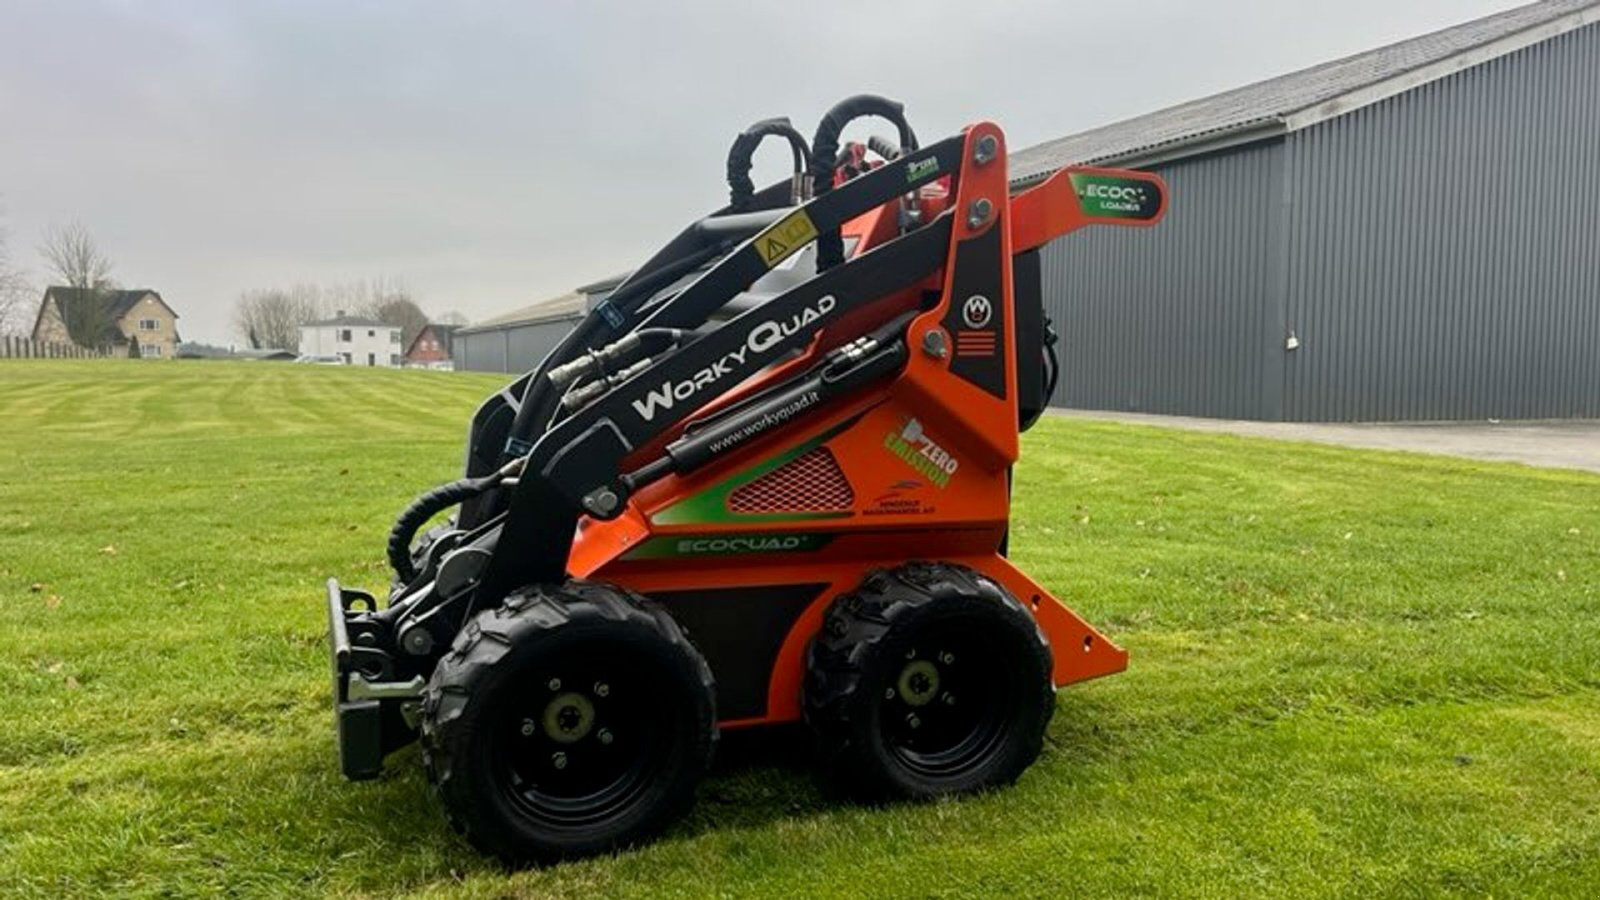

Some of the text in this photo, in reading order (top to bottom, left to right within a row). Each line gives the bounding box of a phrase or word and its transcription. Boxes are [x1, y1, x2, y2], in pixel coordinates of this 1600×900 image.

[709, 391, 819, 453] www.workyquad.it
[885, 431, 950, 489] EMISSION
[920, 440, 958, 475] ZERO
